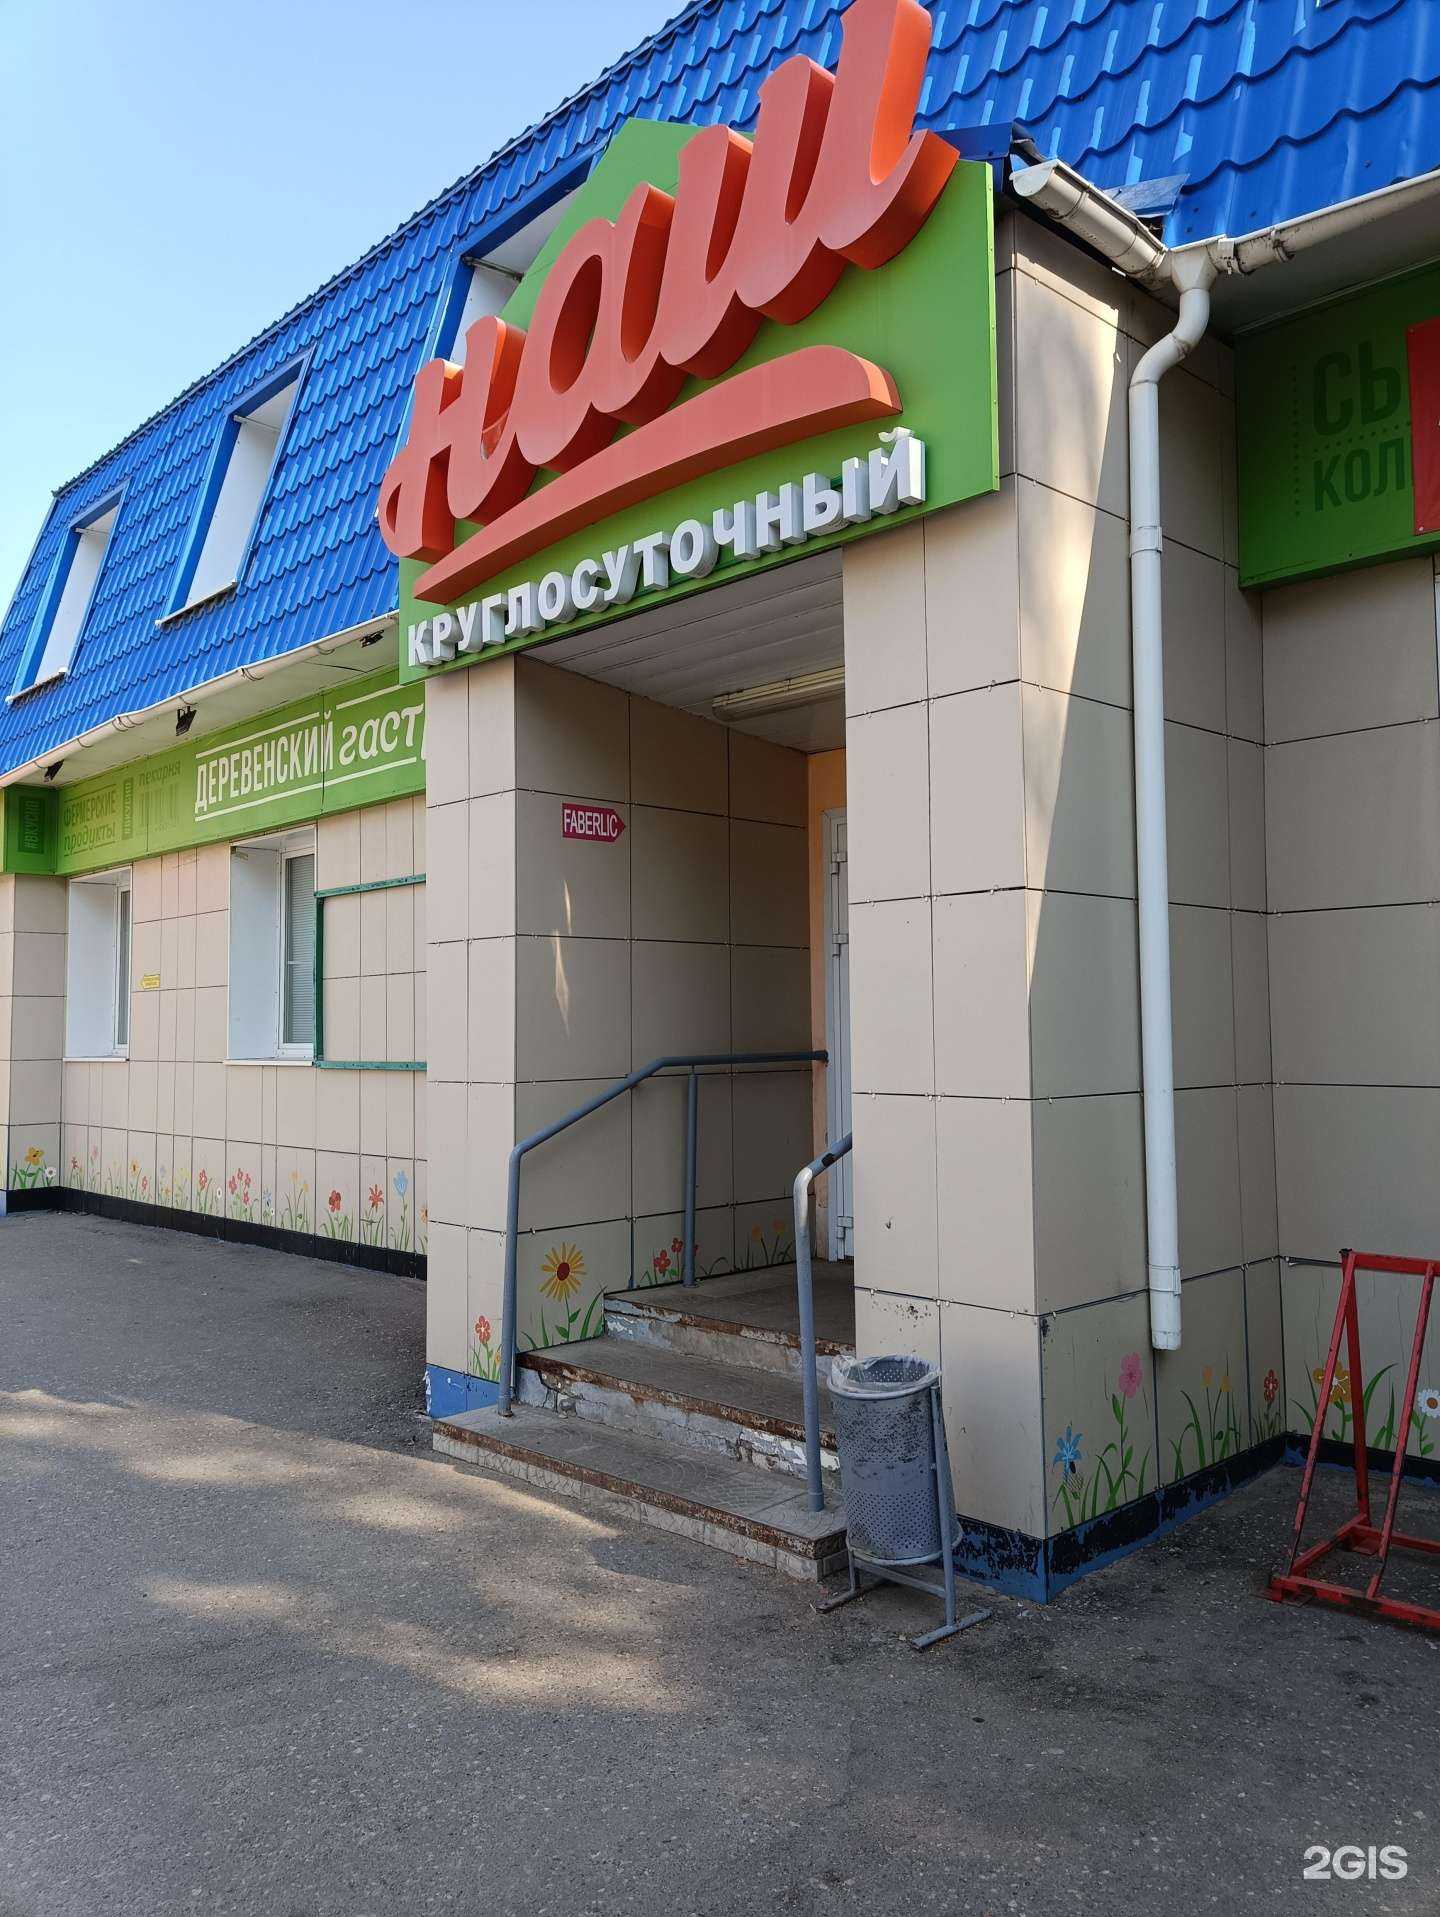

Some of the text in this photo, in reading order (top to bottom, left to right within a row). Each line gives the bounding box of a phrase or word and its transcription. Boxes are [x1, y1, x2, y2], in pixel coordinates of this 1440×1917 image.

[407, 426, 926, 668] КРУГЛОСУТОЧНЫЙ
[194, 710, 334, 814] ДЕРЕВЕНСКИЙ
[339, 703, 427, 766] гаст
[564, 809, 618, 837] FABERLIC
